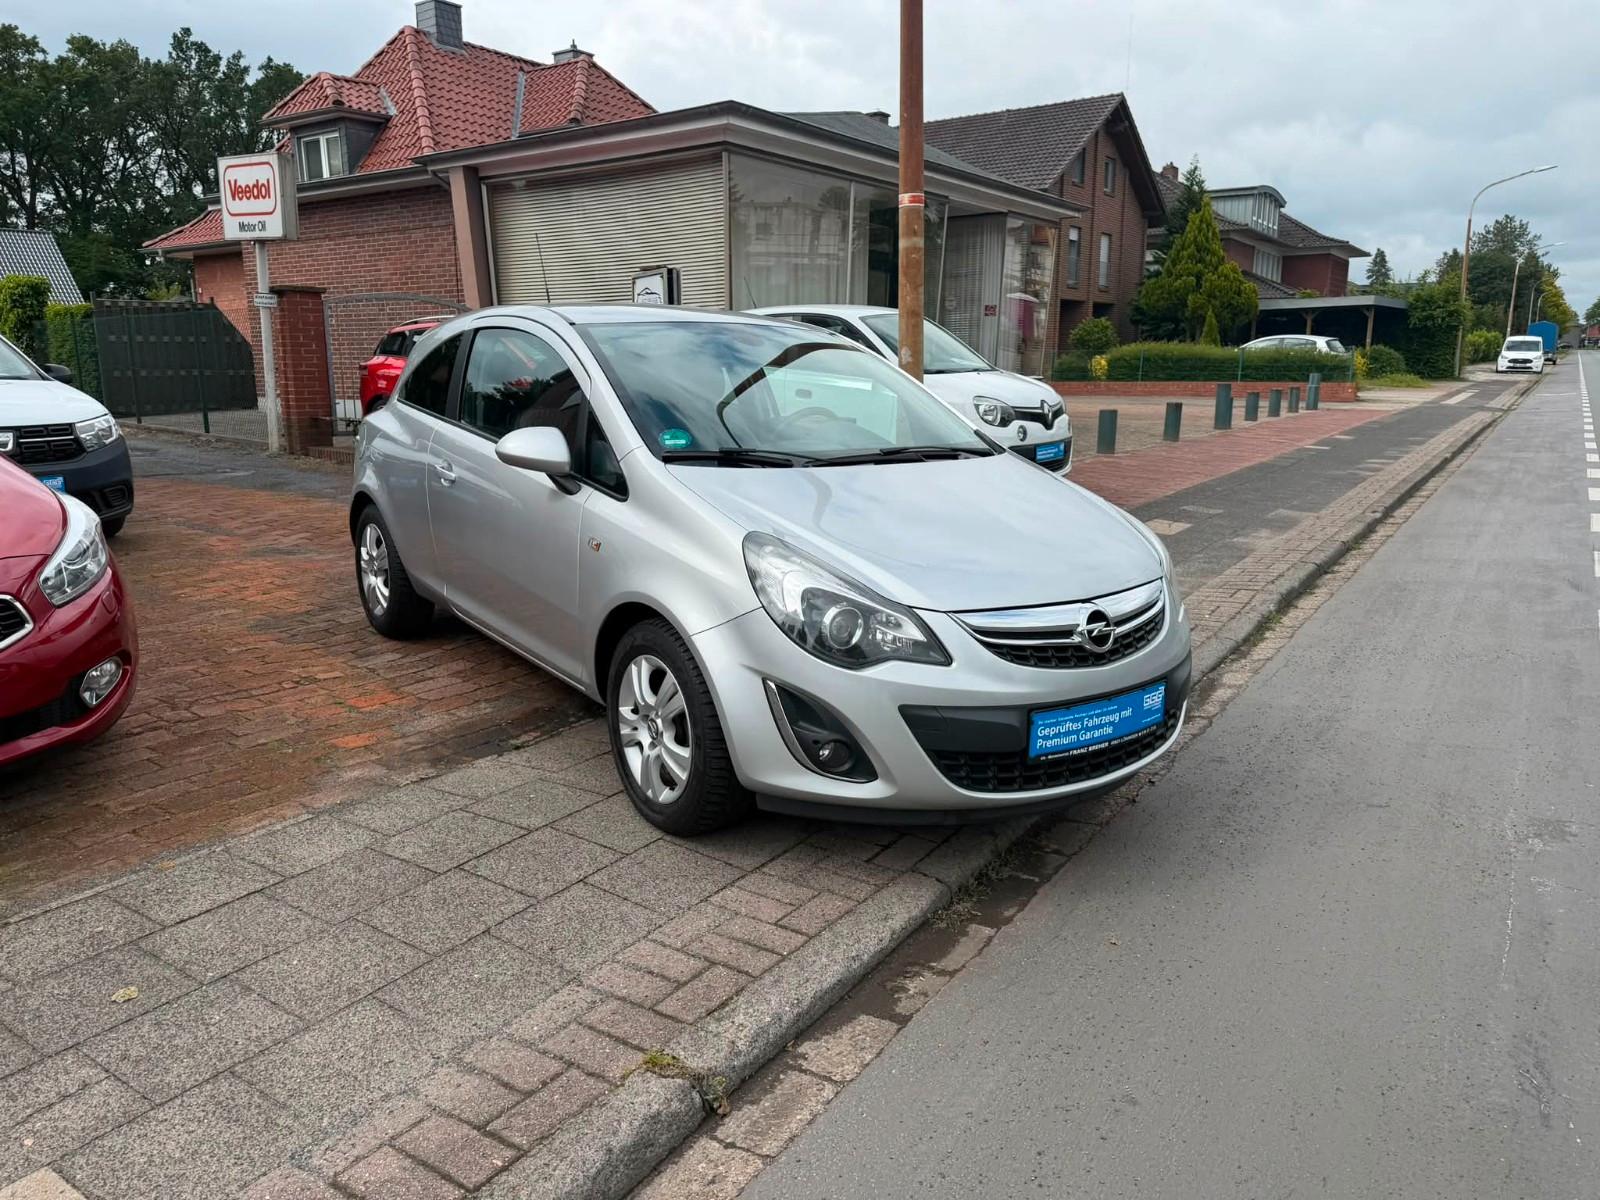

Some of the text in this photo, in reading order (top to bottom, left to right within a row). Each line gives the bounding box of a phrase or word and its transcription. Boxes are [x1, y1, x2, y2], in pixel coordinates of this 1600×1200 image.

[228, 178, 271, 201] Veedol
[238, 220, 266, 232] Motor Oil
[1037, 721, 1082, 737] Geprüftes
[1083, 711, 1120, 727] Fahrzeug
[1120, 706, 1133, 719] mit
[1036, 734, 1078, 749] Premium
[1079, 724, 1113, 741] Garantie
